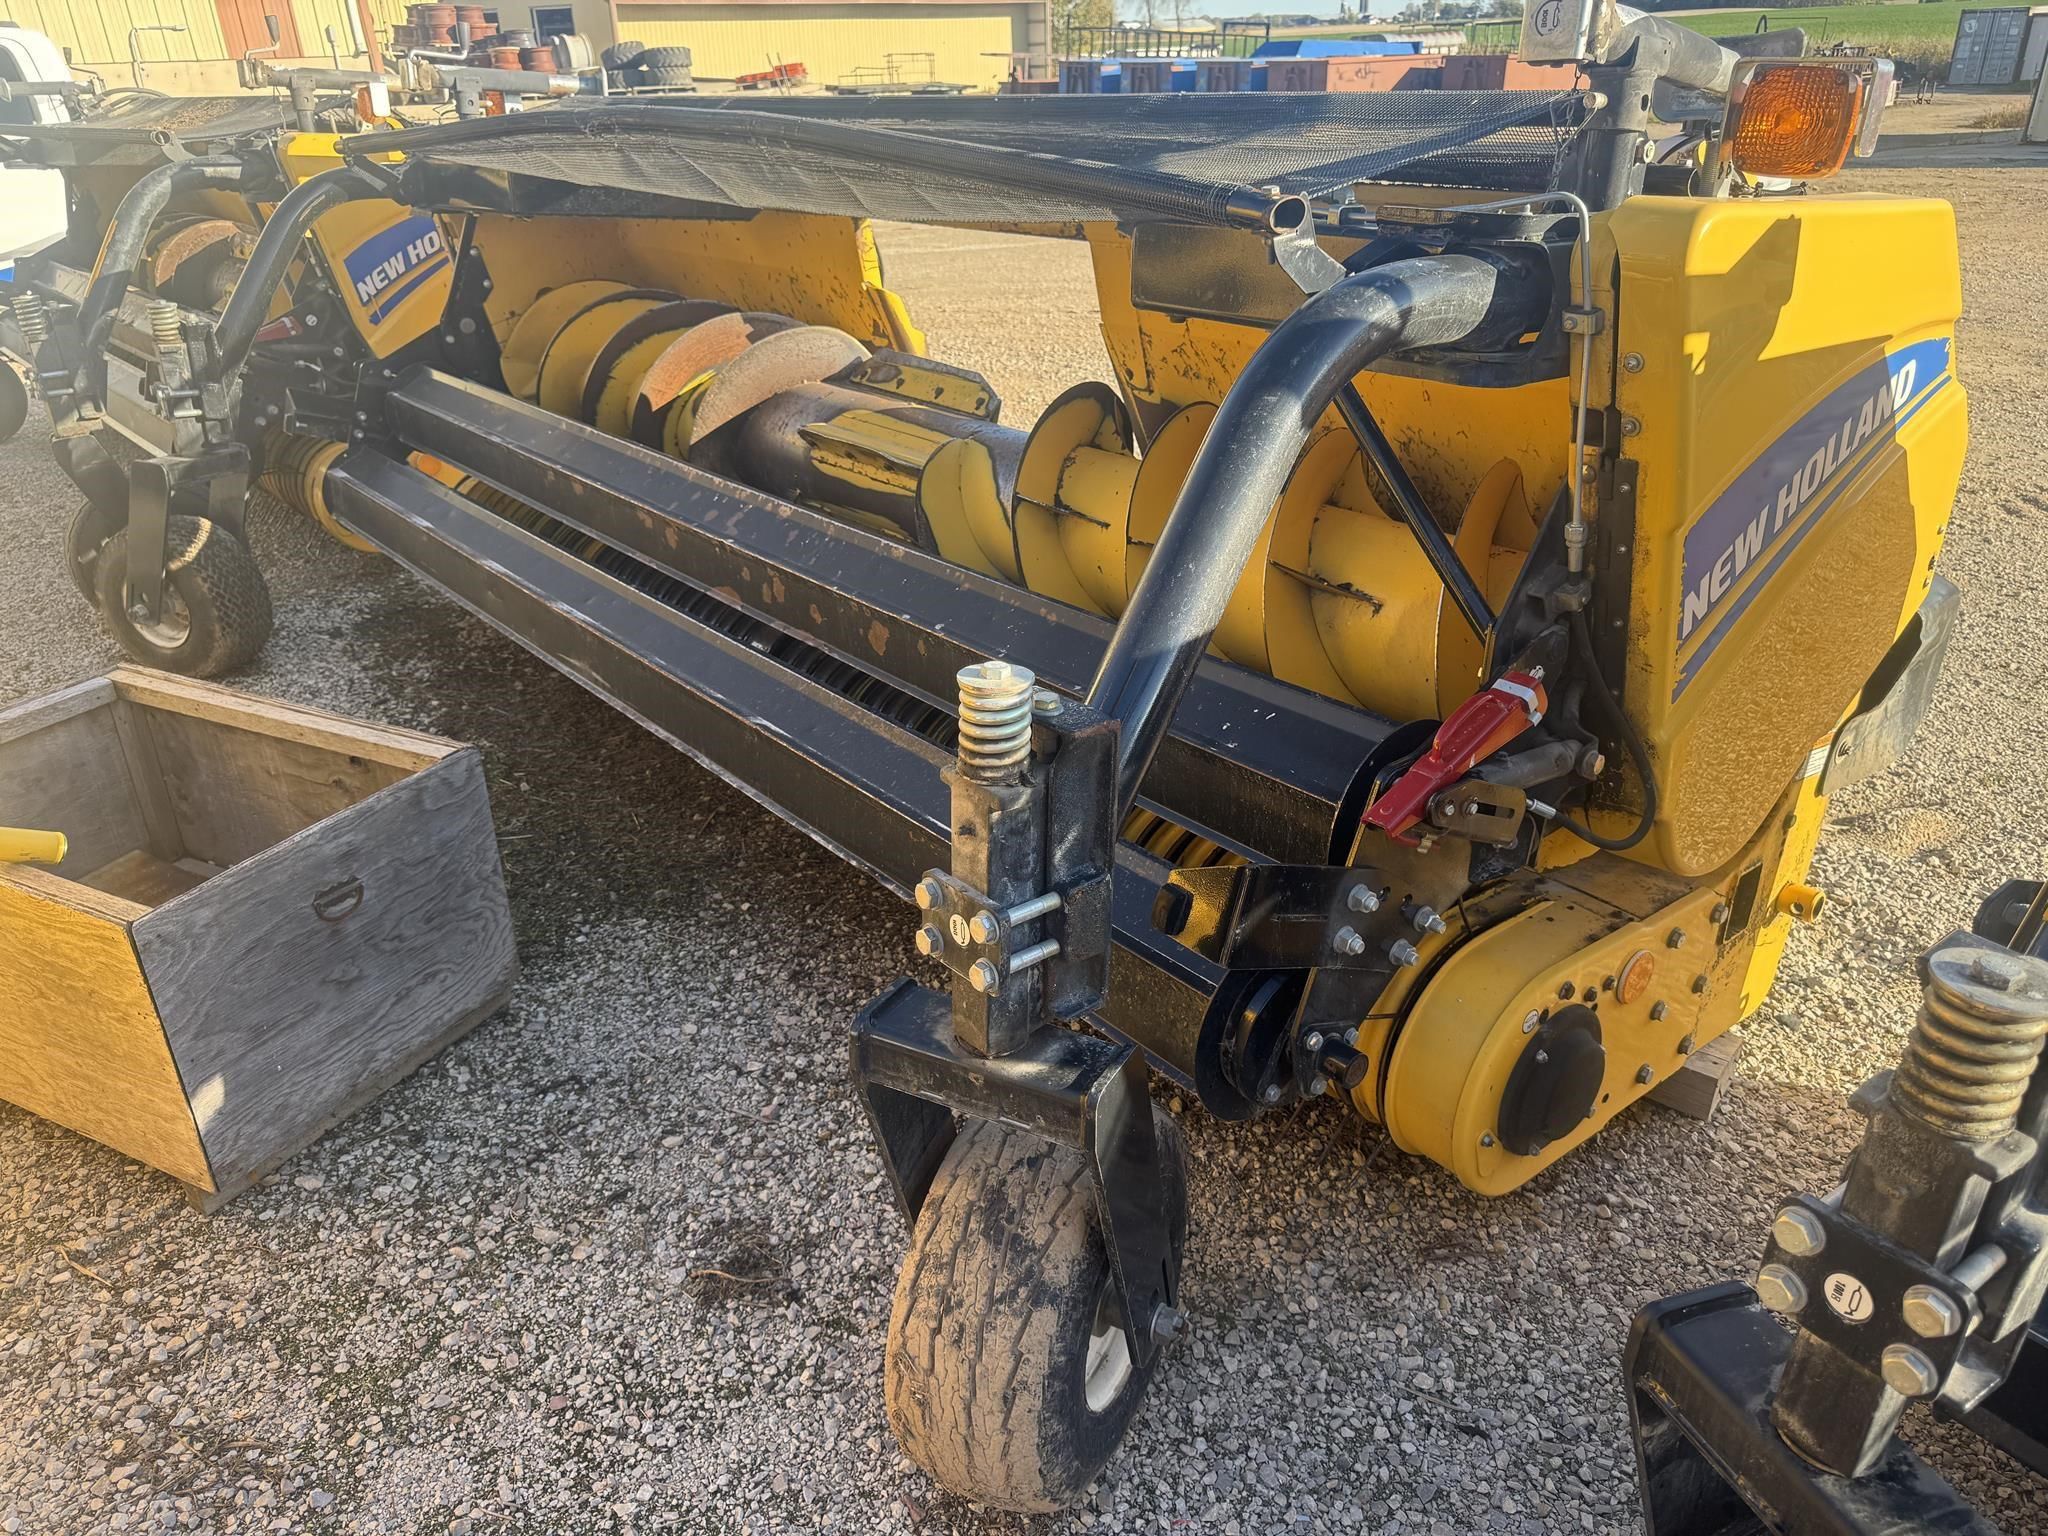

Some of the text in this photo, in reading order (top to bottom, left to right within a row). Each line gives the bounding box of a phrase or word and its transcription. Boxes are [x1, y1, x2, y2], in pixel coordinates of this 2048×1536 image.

[357, 251, 406, 303] NEW
[1682, 359, 1917, 639] NEW HOLLAND
